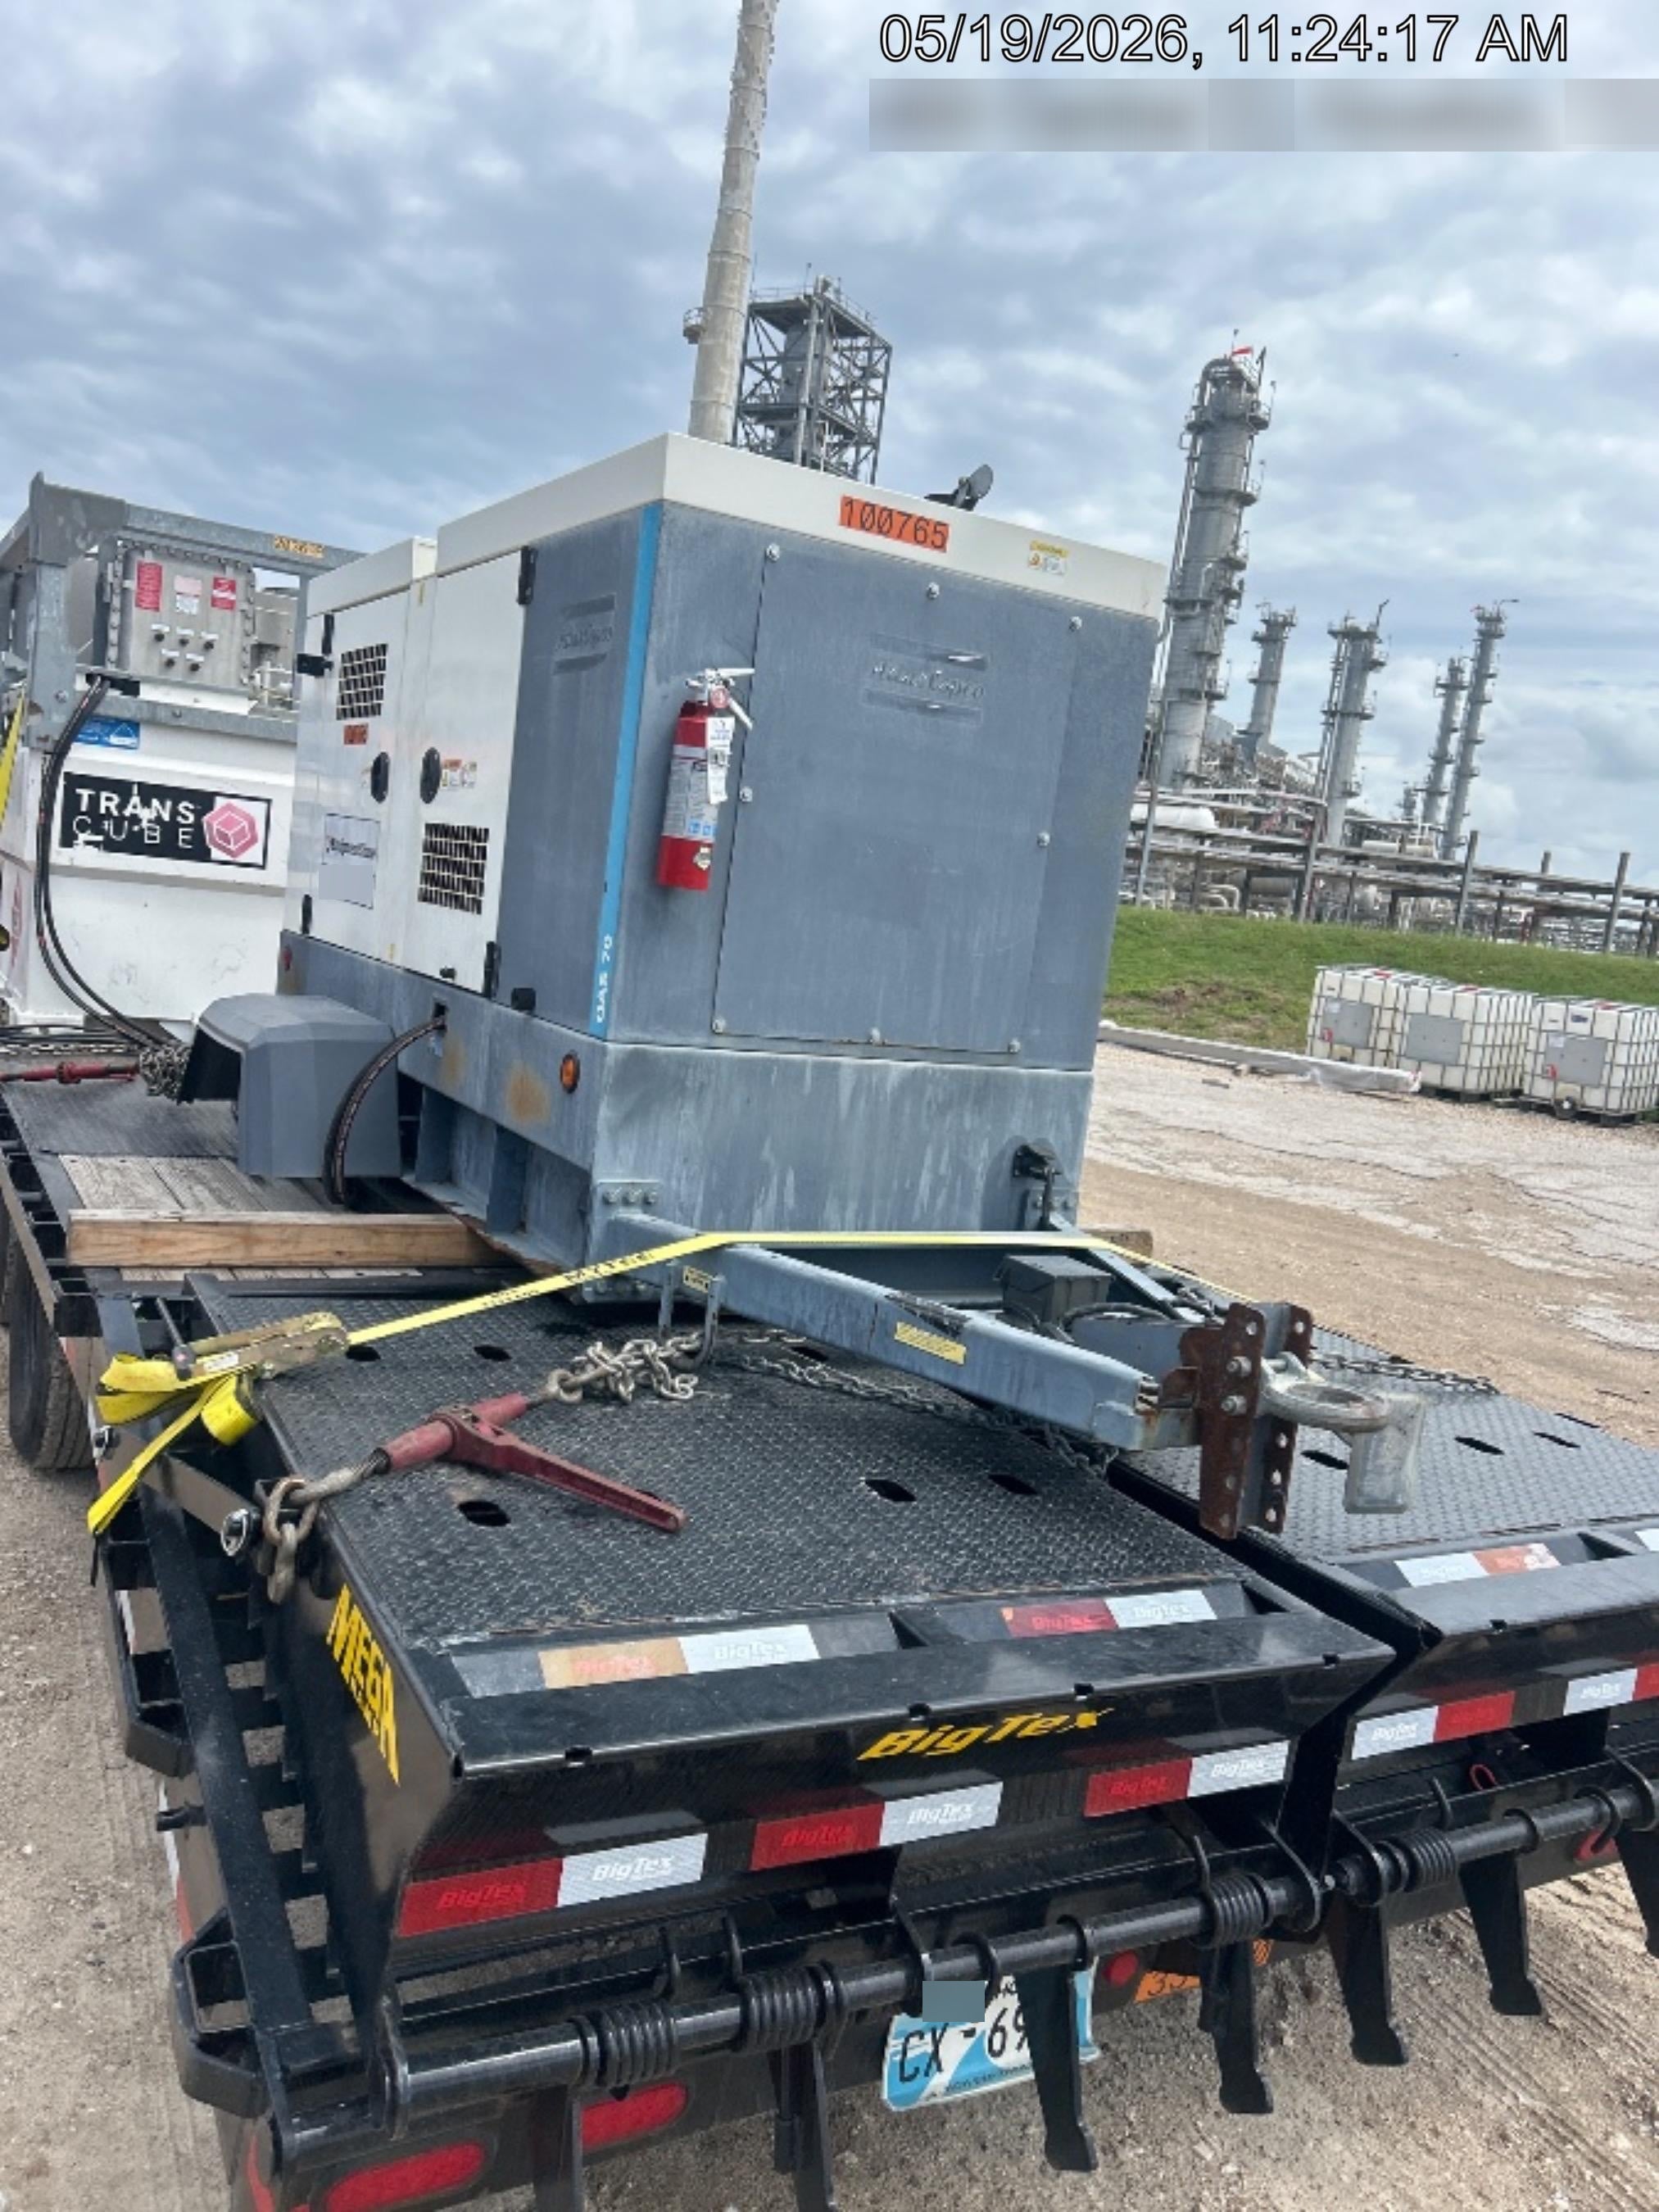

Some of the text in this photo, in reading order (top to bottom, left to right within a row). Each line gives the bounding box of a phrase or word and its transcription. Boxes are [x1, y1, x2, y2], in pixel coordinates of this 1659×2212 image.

[844, 499, 947, 549] 100765
[75, 788, 196, 824] TRANS
[72, 815, 195, 849] CUBE
[326, 1582, 400, 1787] MEGA
